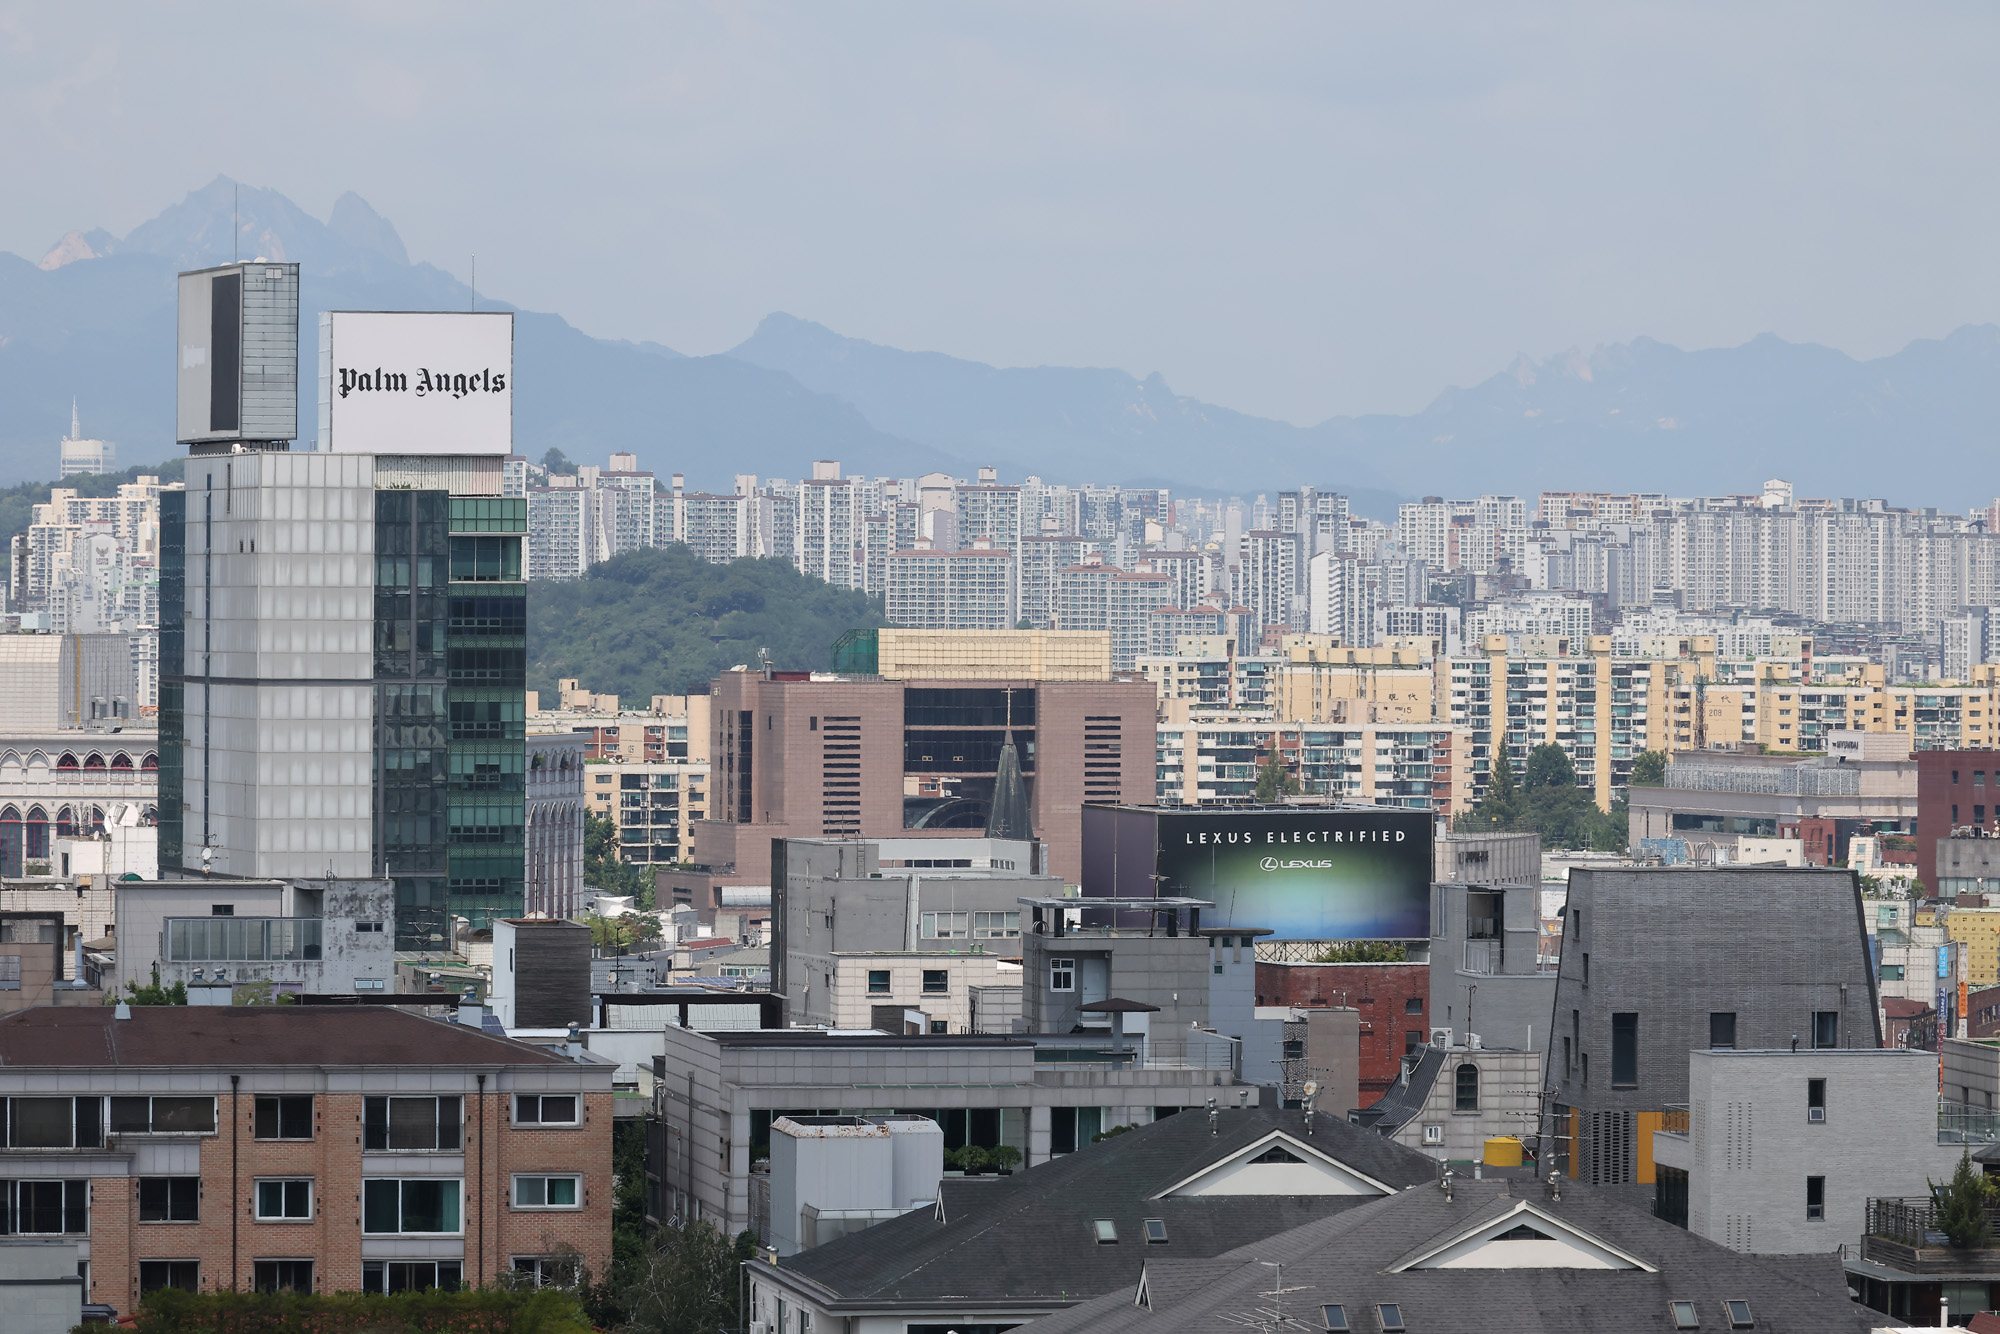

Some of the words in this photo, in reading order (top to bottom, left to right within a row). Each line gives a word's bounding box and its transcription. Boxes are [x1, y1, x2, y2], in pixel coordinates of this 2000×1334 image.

[338, 367, 408, 399] Palm
[415, 367, 506, 399] Angels
[1708, 709, 1723, 717] 208
[1186, 832, 1252, 844] LEXUS
[1267, 830, 1406, 843] ELECTRIFIED
[1280, 859, 1333, 869] LEXUS
